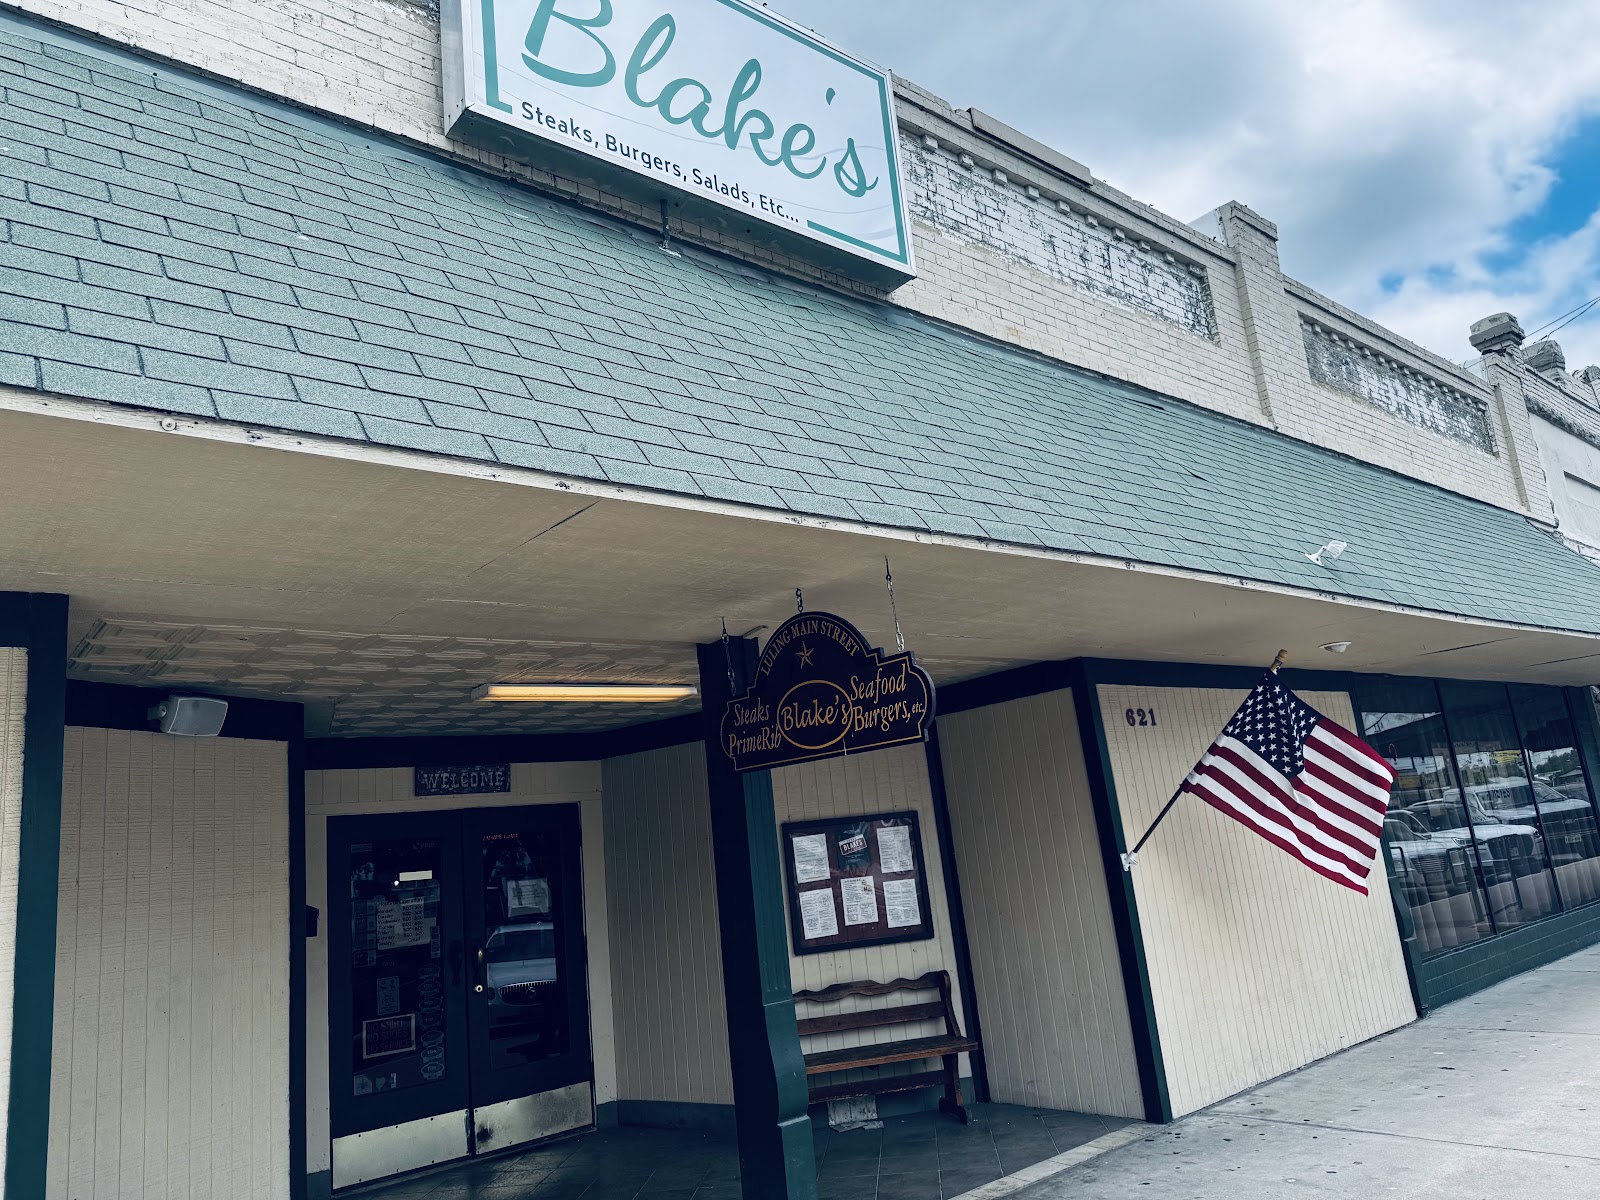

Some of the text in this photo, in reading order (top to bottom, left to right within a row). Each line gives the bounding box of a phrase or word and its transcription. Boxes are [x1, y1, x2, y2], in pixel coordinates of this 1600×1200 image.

[521, 0, 879, 198] Blake's
[521, 101, 800, 223] Steaks, Burgers, Salads, Etc...
[761, 620, 860, 676] LULING MAIN STREET
[850, 663, 907, 704] Seafood
[733, 697, 770, 727] Steaks
[781, 695, 852, 731] Blake's
[852, 699, 911, 732] Burgers,
[1125, 708, 1157, 727] 621
[422, 771, 505, 789] WELCOME
[367, 1022, 378, 1032] NO
[381, 1029, 408, 1041] SHOES
[380, 1038, 410, 1051] SERVICE
